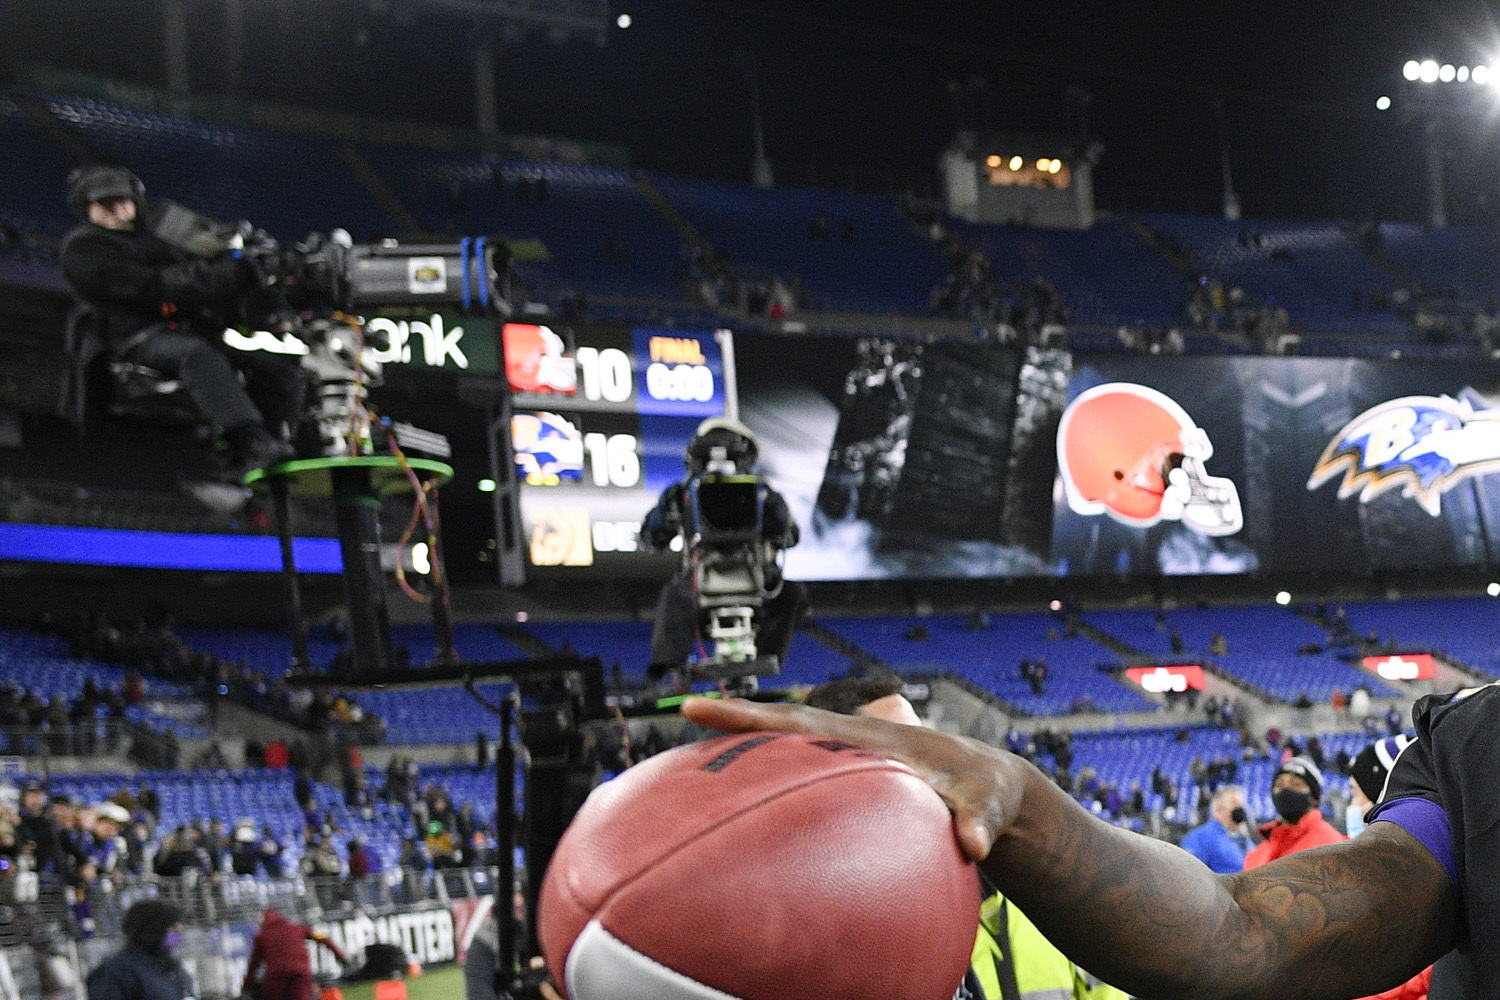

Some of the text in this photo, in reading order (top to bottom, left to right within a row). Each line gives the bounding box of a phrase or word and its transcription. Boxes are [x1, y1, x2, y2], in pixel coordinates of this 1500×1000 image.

[360, 313, 469, 369] ank
[576, 347, 632, 401] 10
[646, 362, 713, 402] 0:00
[584, 432, 640, 487] 16
